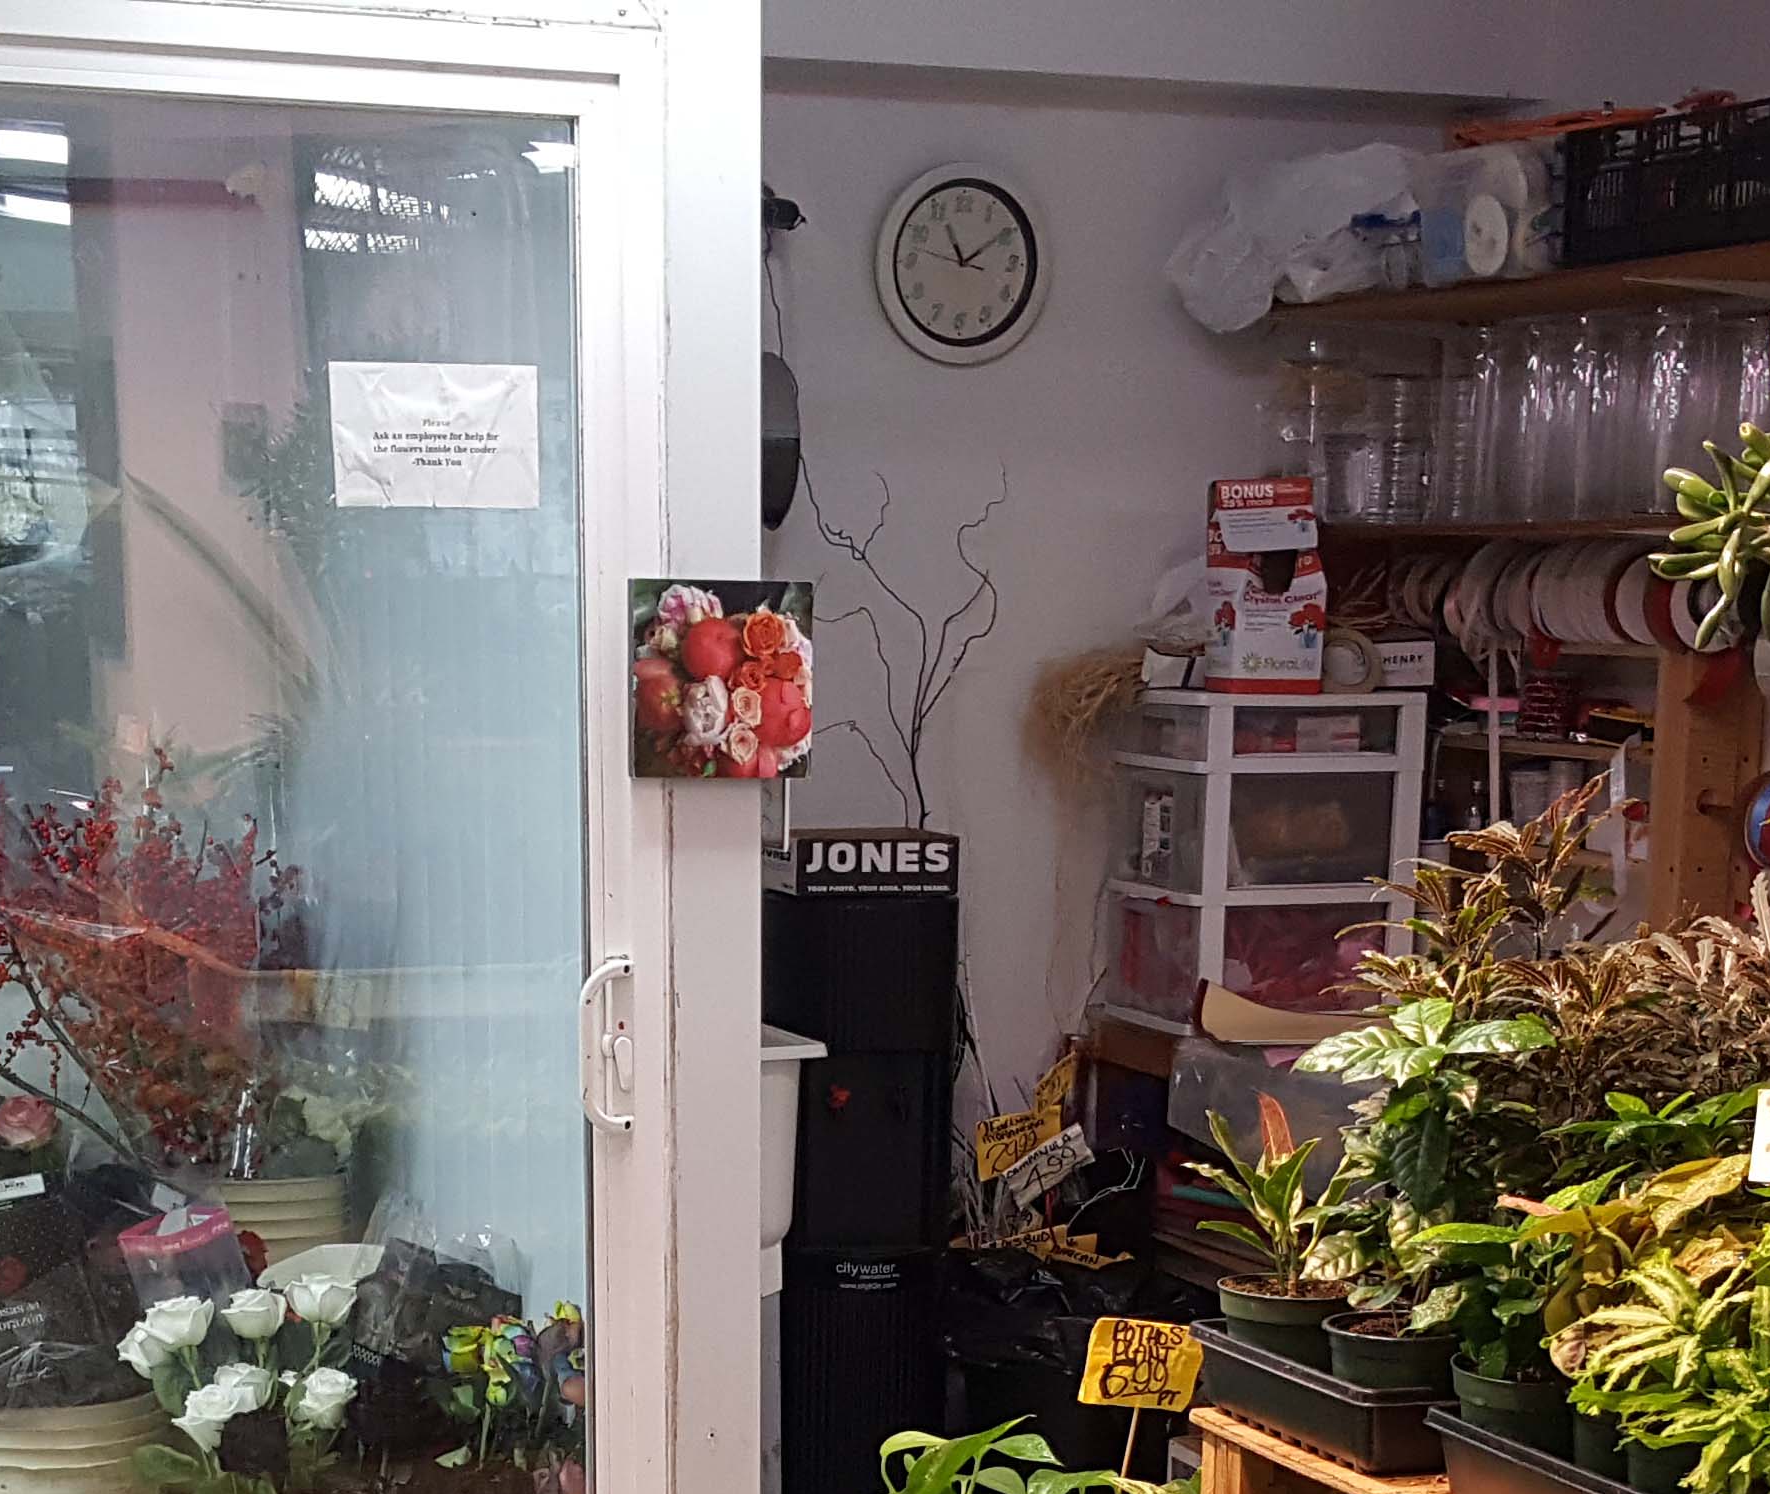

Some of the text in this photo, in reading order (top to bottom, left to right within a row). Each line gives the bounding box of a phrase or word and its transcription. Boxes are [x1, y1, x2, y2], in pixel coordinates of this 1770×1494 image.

[422, 418, 451, 427] Please
[373, 432, 389, 440] Ask
[405, 432, 448, 443] employee
[449, 432, 463, 441] for
[465, 432, 485, 443] help
[487, 433, 500, 441] for
[373, 445, 388, 453] the
[391, 445, 423, 454] flowers
[425, 445, 451, 453] inside
[454, 445, 468, 454] the
[445, 458, 462, 467] You
[1221, 484, 1274, 499] BONUS
[1383, 653, 1424, 666] HENRY
[805, 841, 951, 874] JONES
[836, 1261, 896, 1277] citywater
[1113, 1319, 1184, 1346] POTHOS
